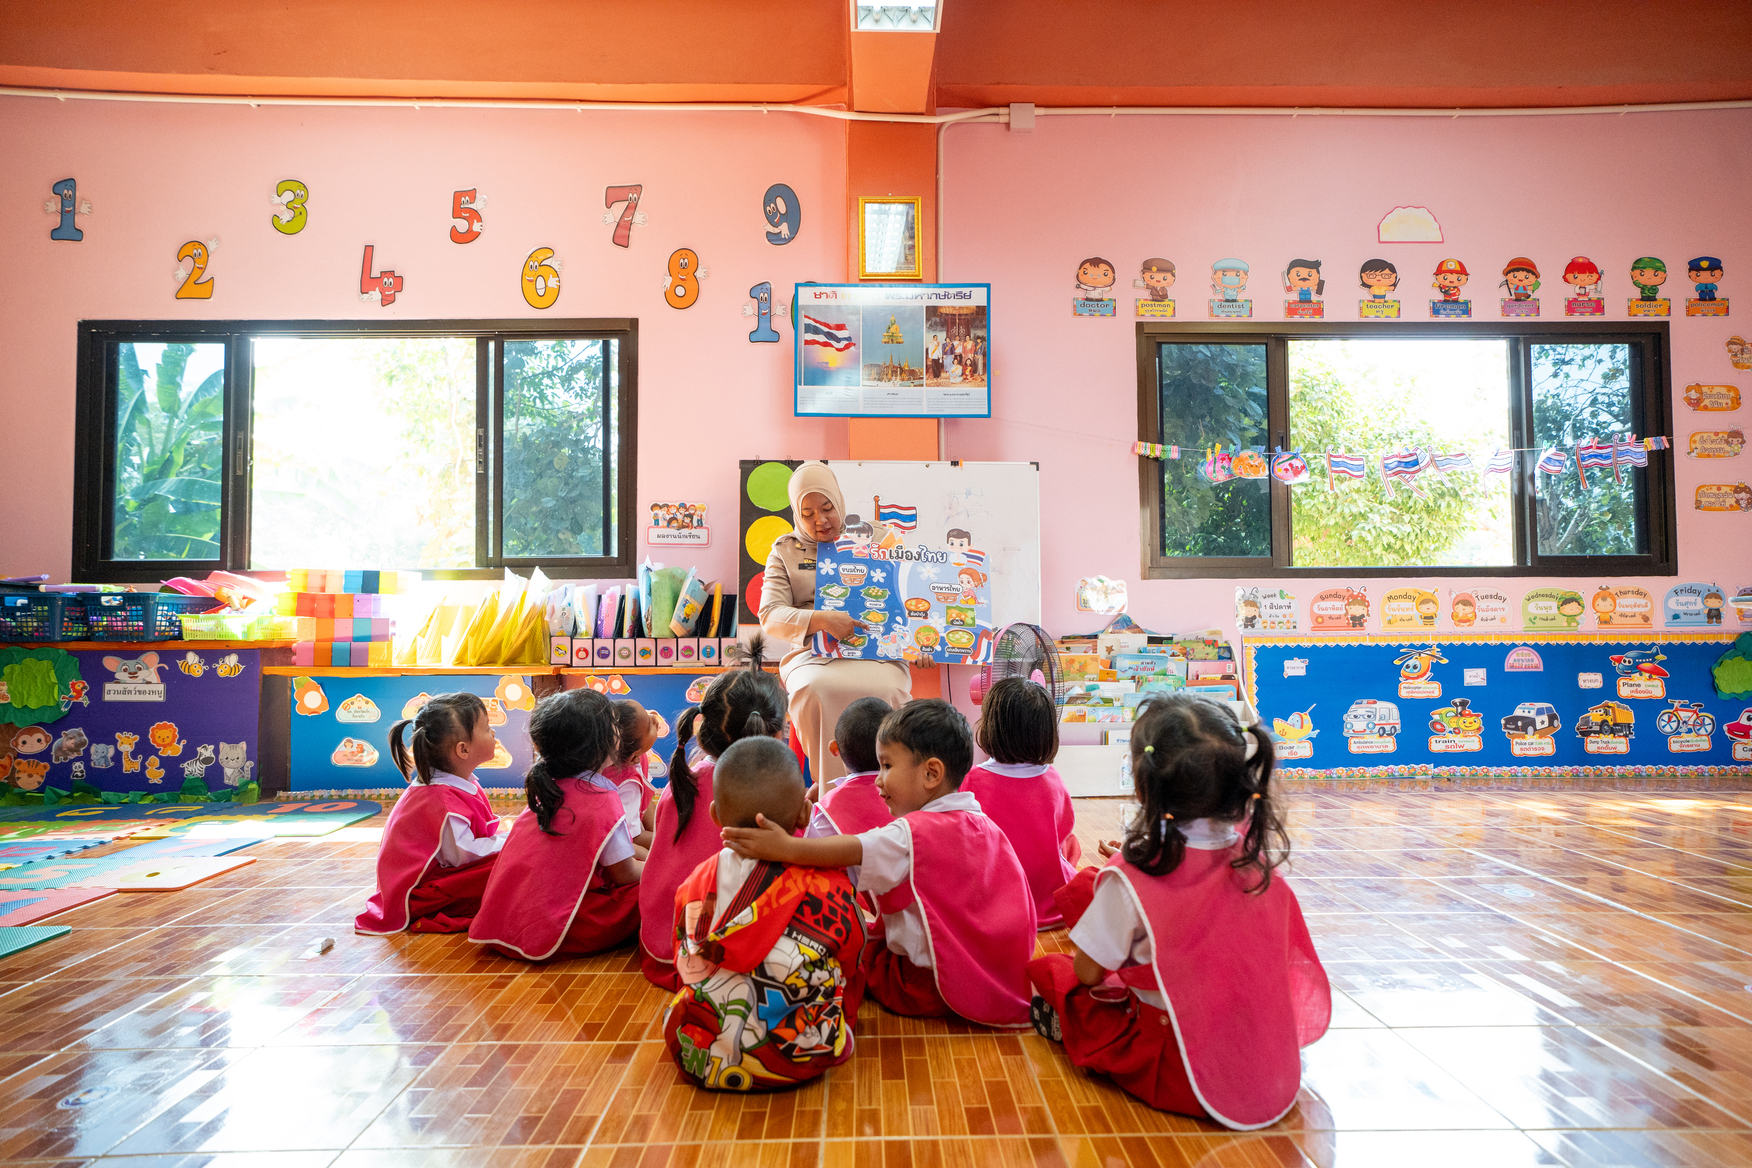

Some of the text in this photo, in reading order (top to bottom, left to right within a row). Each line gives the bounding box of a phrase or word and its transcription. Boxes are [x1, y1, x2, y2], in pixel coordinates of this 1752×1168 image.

[50, 177, 84, 242] 1
[272, 179, 309, 235] 3
[450, 187, 484, 244] 5
[604, 183, 643, 248] 7
[763, 183, 802, 245] 9
[175, 240, 214, 300] 2
[360, 244, 404, 307] 4
[521, 247, 561, 310] 6
[664, 247, 700, 310] 8
[813, 290, 837, 300] ชาติ
[885, 290, 972, 300] พระมหากษัตริย์
[1434, 302, 1466, 310] fireman
[870, 542, 947, 563] รักเมืองไทย
[932, 584, 961, 592] อาหารไทย
[1673, 586, 1702, 596] Friday
[1262, 592, 1277, 600] Week
[1320, 592, 1346, 601] Sunday
[1387, 592, 1417, 602] Monday
[1475, 592, 1507, 603] Tuesday
[1525, 592, 1560, 602] Wednesday
[1615, 589, 1648, 598] Thursday
[1269, 602, 1292, 610] สัปดาห์
[1316, 604, 1343, 612] วันอาทิตย์
[1387, 604, 1414, 612] วันจันทร์
[1477, 604, 1506, 612] วันอังคาร
[1674, 598, 1698, 608] วันศุกร์
[1534, 604, 1552, 613] วันพุธ
[106, 686, 162, 698] สวนสัตว์ของหนู
[266, 802, 358, 814] 10
[705, 1056, 753, 1091] 10
